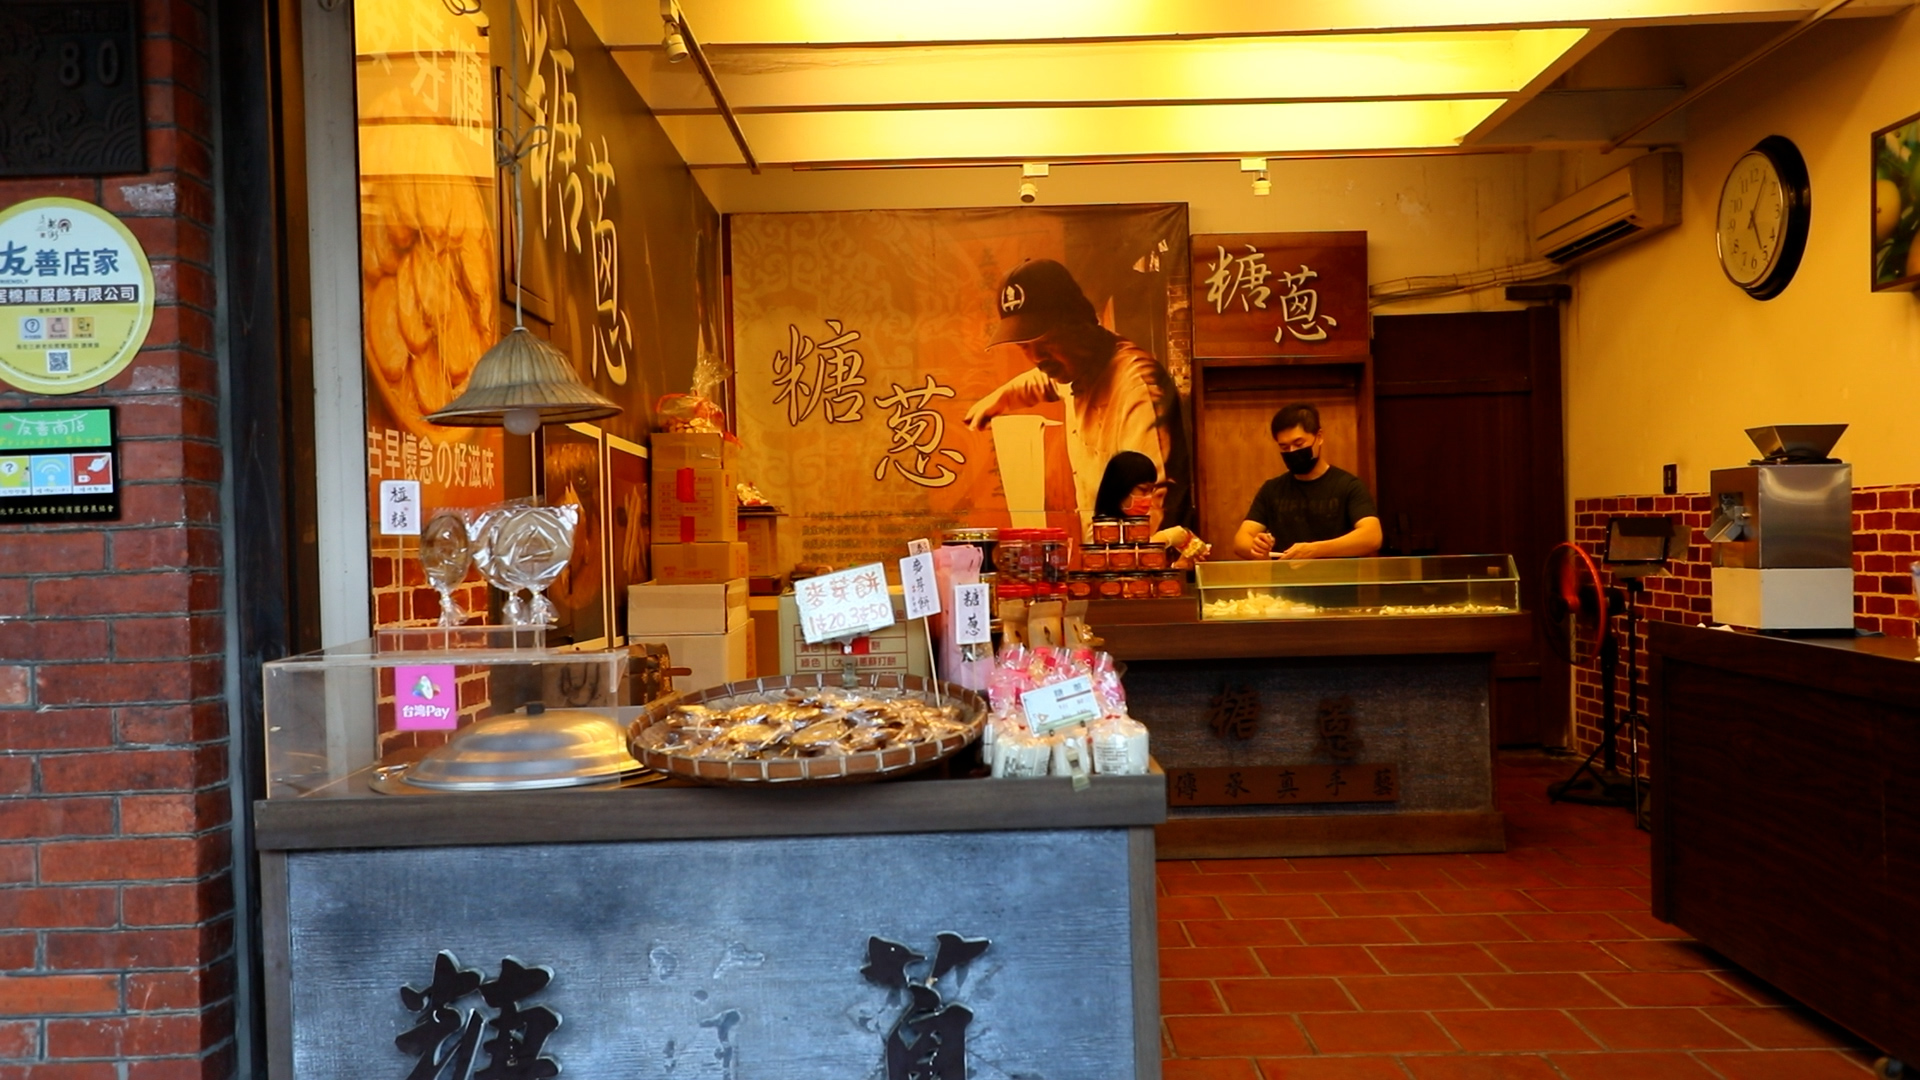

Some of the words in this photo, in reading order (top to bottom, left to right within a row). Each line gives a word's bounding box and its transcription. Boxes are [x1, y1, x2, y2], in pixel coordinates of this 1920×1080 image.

[59, 39, 119, 86] 80
[0, 240, 119, 277] 友善店家
[367, 426, 496, 490] 古早懷念の好滋味
[1174, 768, 1395, 801] 傳承真手藝
